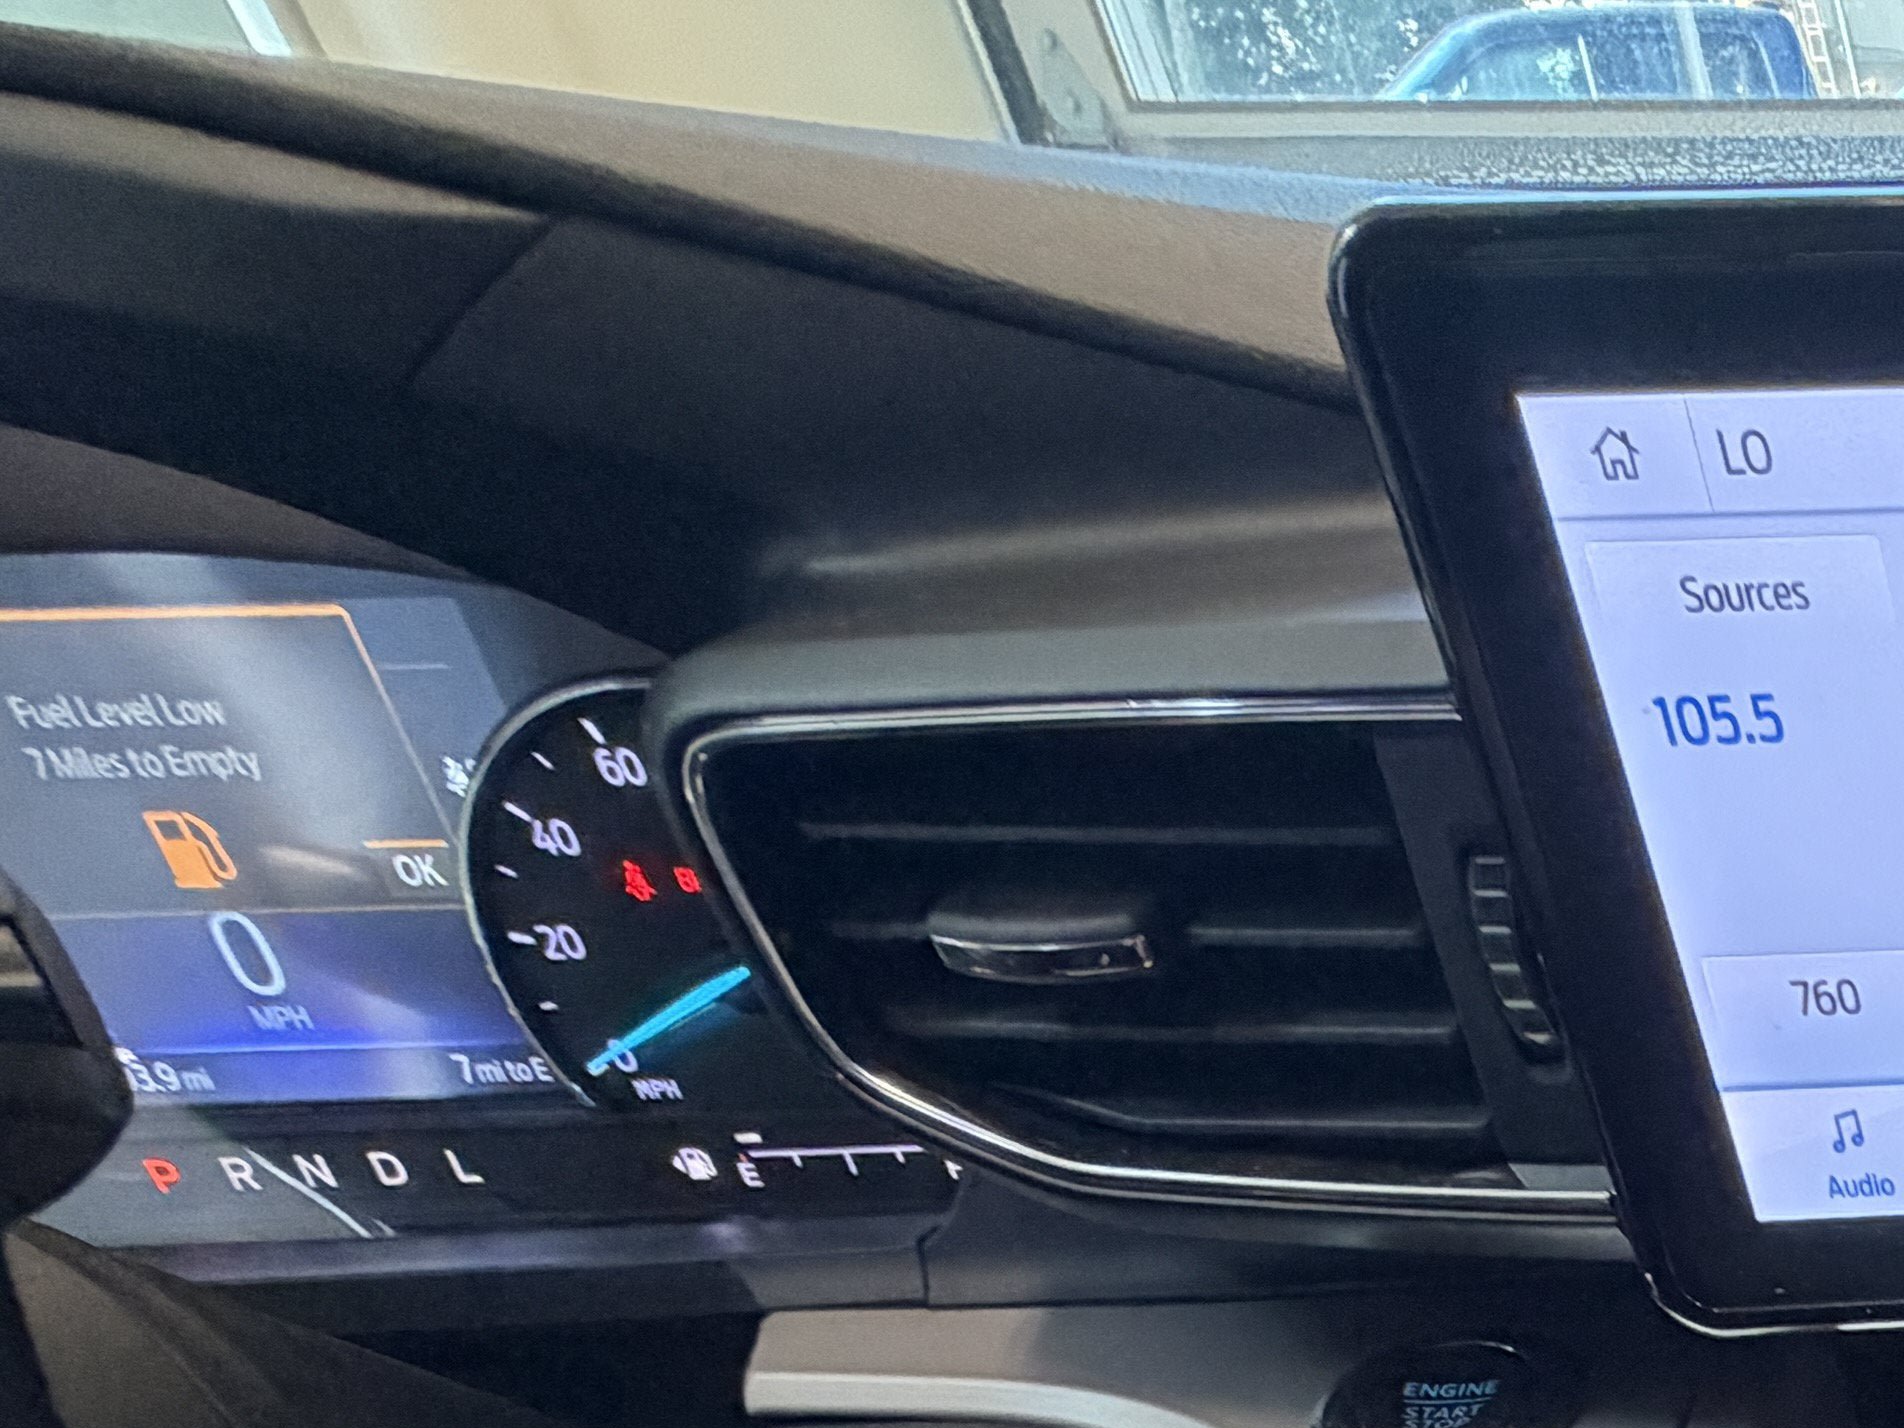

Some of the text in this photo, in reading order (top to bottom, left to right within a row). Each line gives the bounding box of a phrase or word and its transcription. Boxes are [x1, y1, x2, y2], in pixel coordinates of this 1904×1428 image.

[1716, 428, 1773, 477] LO
[1679, 573, 1811, 614] Sources
[6, 694, 227, 730] Fuel Level Low
[1652, 692, 1785, 747] 105.5
[23, 744, 262, 782] 7 Miles to Empty
[594, 746, 648, 786] 60
[531, 818, 582, 857] 40
[392, 853, 450, 887] OK
[209, 911, 286, 997] 0
[533, 924, 588, 961] 20
[1789, 977, 1863, 1016] 760
[247, 1005, 316, 1031] MPH
[450, 1053, 555, 1084] 7 mi to E
[631, 1079, 684, 1101] MPH
[142, 1149, 486, 1194] P R N D L
[735, 1160, 766, 1189] E
[1825, 1170, 1898, 1199] Audio
[1403, 1380, 1498, 1398] ENGINE
[1402, 1404, 1483, 1418] START
